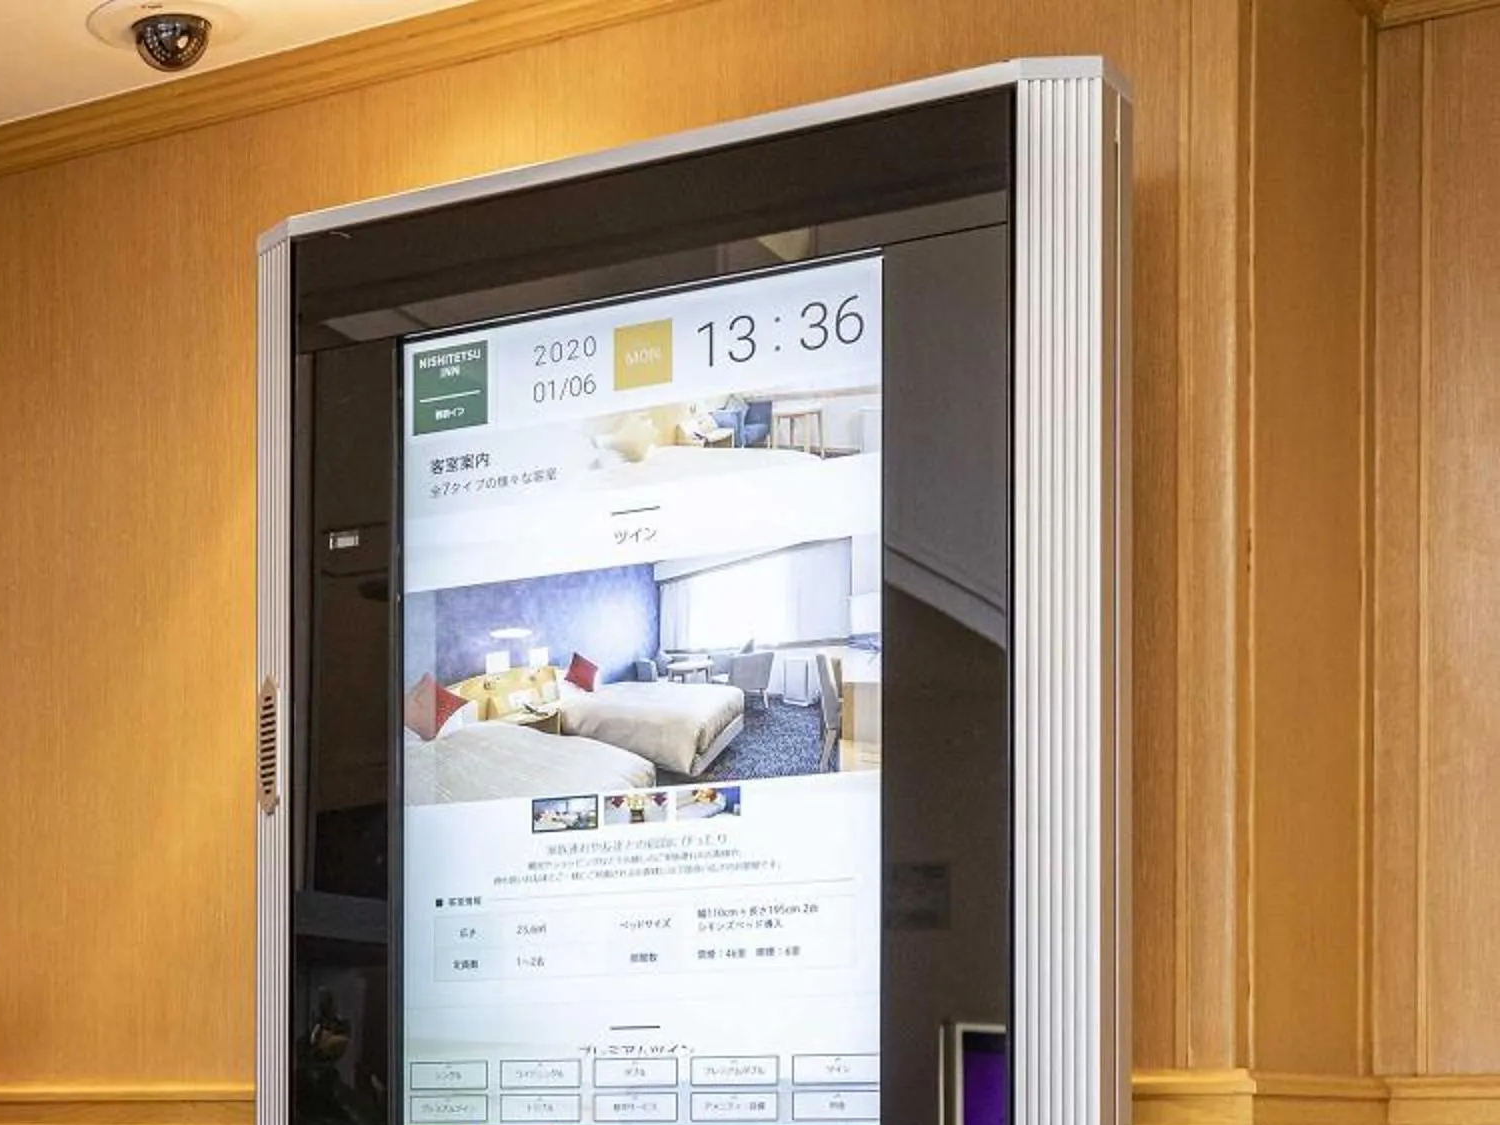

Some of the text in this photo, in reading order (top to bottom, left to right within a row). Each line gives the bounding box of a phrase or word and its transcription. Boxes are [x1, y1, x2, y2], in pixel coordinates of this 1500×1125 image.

[419, 348, 481, 369] NISHITETSU
[533, 335, 597, 366] 2020
[440, 365, 461, 378] INN
[533, 373, 597, 403] 01/06
[430, 452, 490, 475] 客室案内
[614, 527, 657, 545] ツイン
